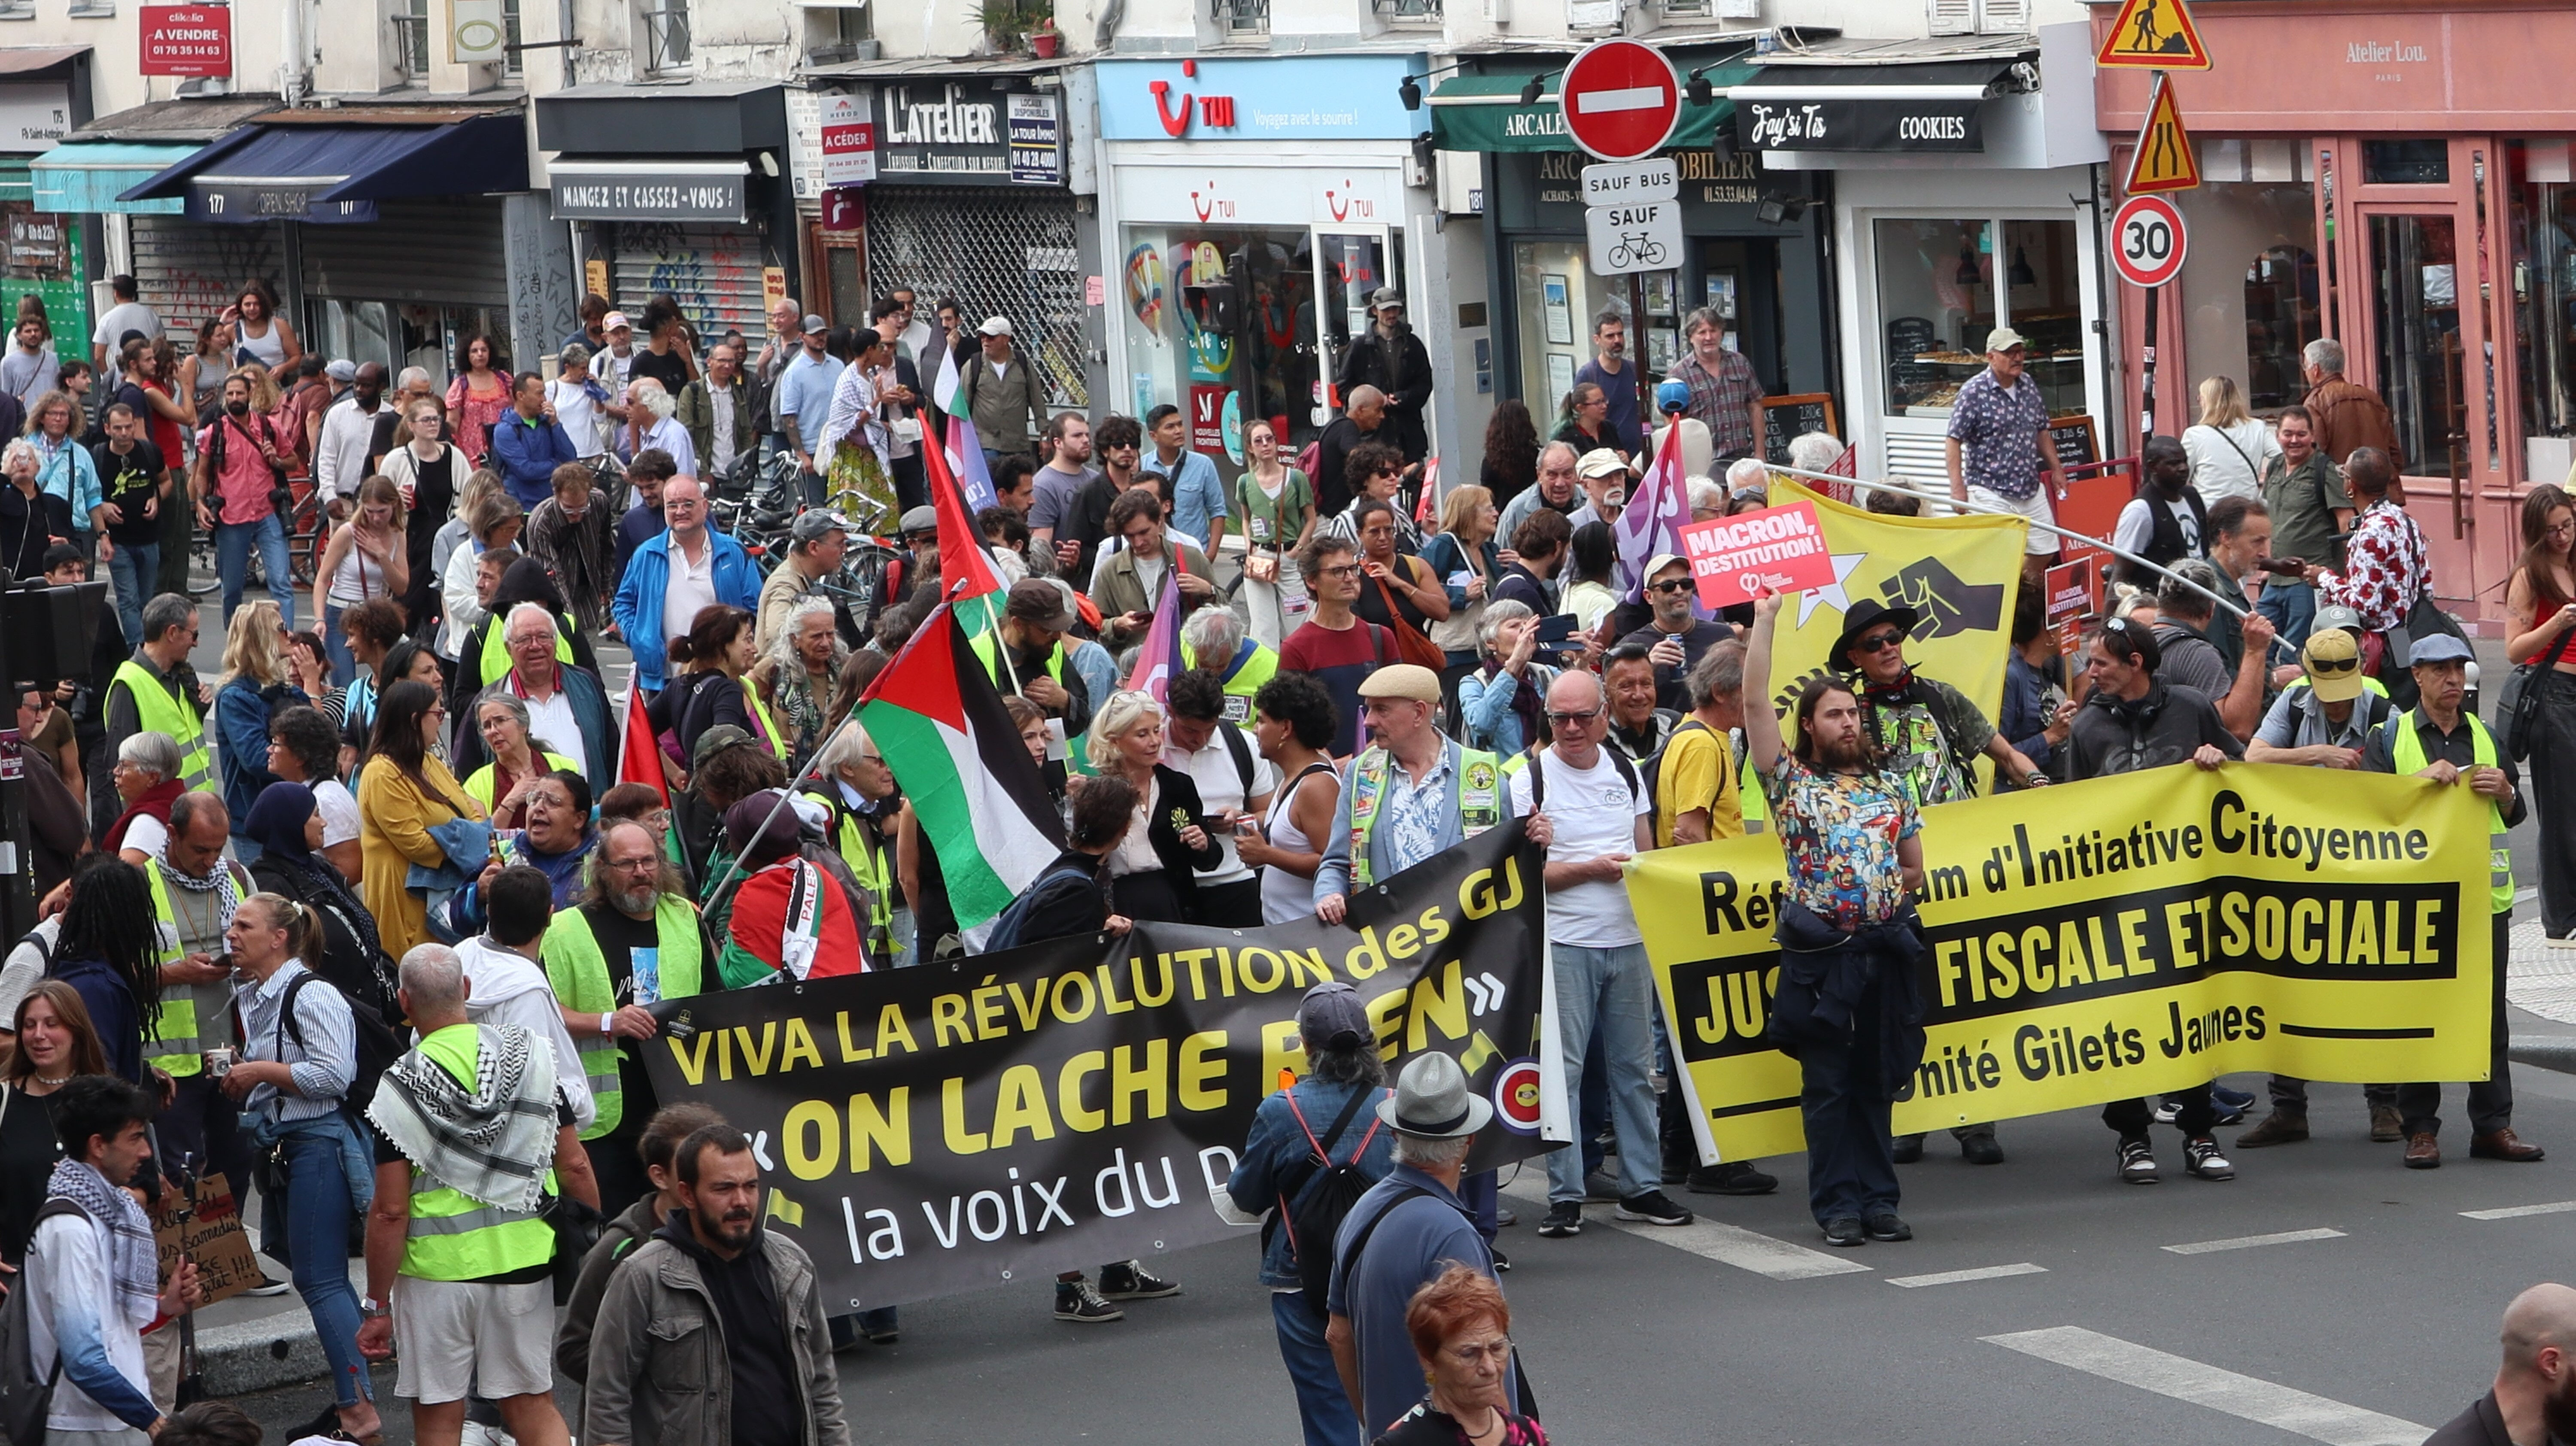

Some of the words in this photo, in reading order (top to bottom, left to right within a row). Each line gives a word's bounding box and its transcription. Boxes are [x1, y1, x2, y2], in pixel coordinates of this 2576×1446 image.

[154, 29, 164, 40] A
[167, 29, 219, 41] VENDRE
[153, 46, 163, 55] 01
[166, 46, 177, 55] 76
[194, 46, 205, 55] 14
[2346, 41, 2392, 63] Atelier
[2396, 41, 2427, 63] Lou.
[2375, 73, 2402, 82] PARIS
[52, 110, 64, 124] 175
[1014, 108, 1049, 118] DISPONIBLES
[1198, 96, 1236, 127] TUI
[1253, 109, 1288, 130] Voyagez
[1290, 112, 1310, 126] avec
[1312, 109, 1319, 125] le
[1322, 109, 1352, 126] sourire
[1010, 128, 1019, 139] LA
[1019, 128, 1036, 140] TOUR
[1505, 113, 1568, 137] ARCALE
[1900, 116, 1965, 140] COOKIES
[825, 135, 833, 148] A
[834, 130, 867, 147] CÉDER
[1013, 150, 1021, 166] 01
[1590, 176, 1631, 192] SAUF
[1640, 173, 1671, 186] BUS
[208, 193, 224, 214] 177
[260, 192, 282, 214] OPEN
[285, 192, 306, 213] SHOP
[563, 186, 609, 208] MANGEZ
[616, 186, 627, 208] ET
[1470, 192, 1483, 210] 181
[1541, 190, 1570, 202] ACHATS
[1704, 185, 1757, 203] 01.53.33.04.04
[1218, 200, 1235, 218] TUI
[1354, 199, 1374, 217] TUI
[1609, 207, 1659, 226] SAUF
[2125, 221, 2171, 259] 30
[1686, 510, 1816, 557] MACRON,
[1983, 819, 2203, 893] d'Initiative
[2210, 789, 2428, 872] Citoyenne
[1935, 907, 2156, 1008] FISCALE
[2164, 895, 2211, 969] ET
[2220, 891, 2442, 965] SOCIALE
[665, 1016, 823, 1086] VIVA
[835, 1002, 919, 1064] LA
[931, 945, 1335, 1048] RÉVOLUTION
[1345, 905, 1451, 981] des
[1458, 854, 1525, 922] GJ
[2014, 1020, 2145, 1081] Gilets
[2159, 1000, 2266, 1060] Jaunes
[942, 1030, 1229, 1156] LACHE
[841, 1195, 904, 1264] la
[921, 1166, 1075, 1249] voix
[1094, 1147, 1181, 1218] du
